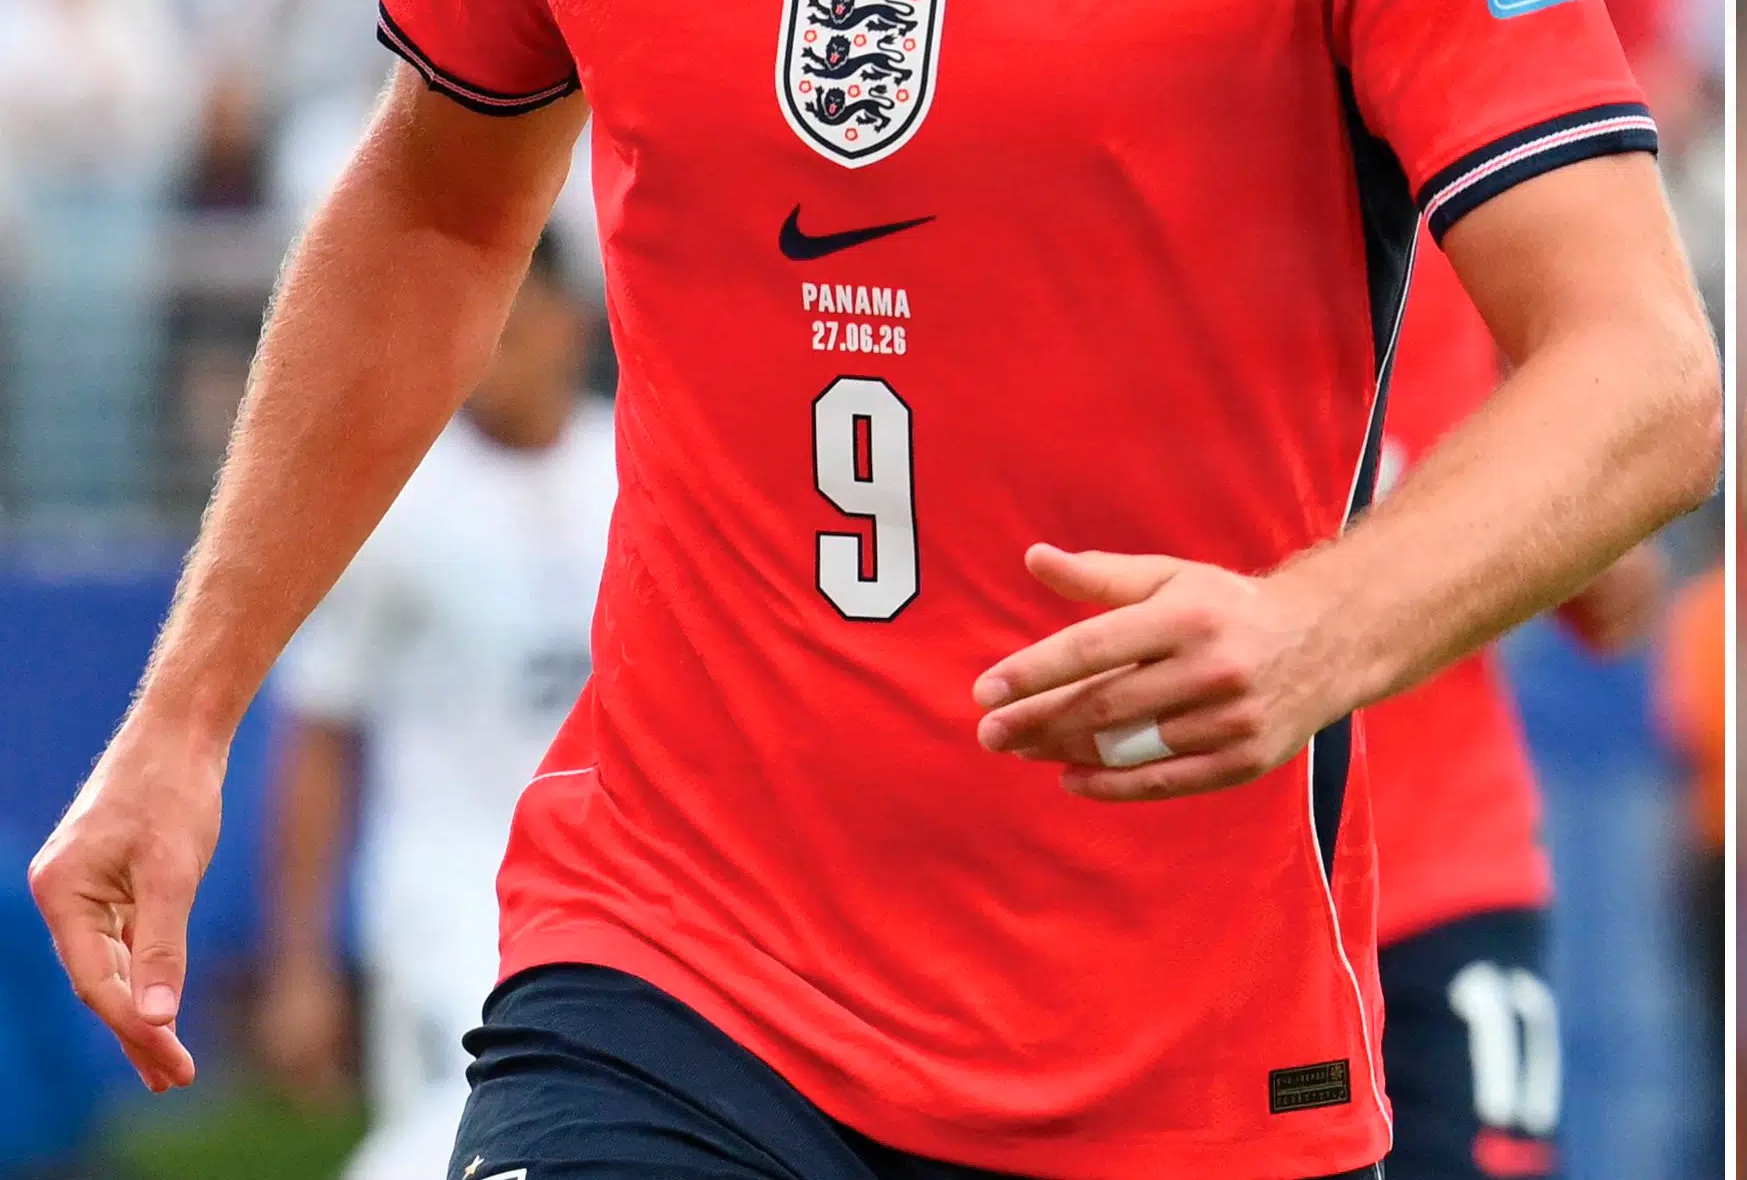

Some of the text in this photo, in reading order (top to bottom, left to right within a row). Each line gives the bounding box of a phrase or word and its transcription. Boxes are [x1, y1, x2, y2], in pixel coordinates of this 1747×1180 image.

[801, 281, 911, 319] PANAMA
[811, 319, 907, 355] 27.06.26
[811, 374, 920, 623] 9
